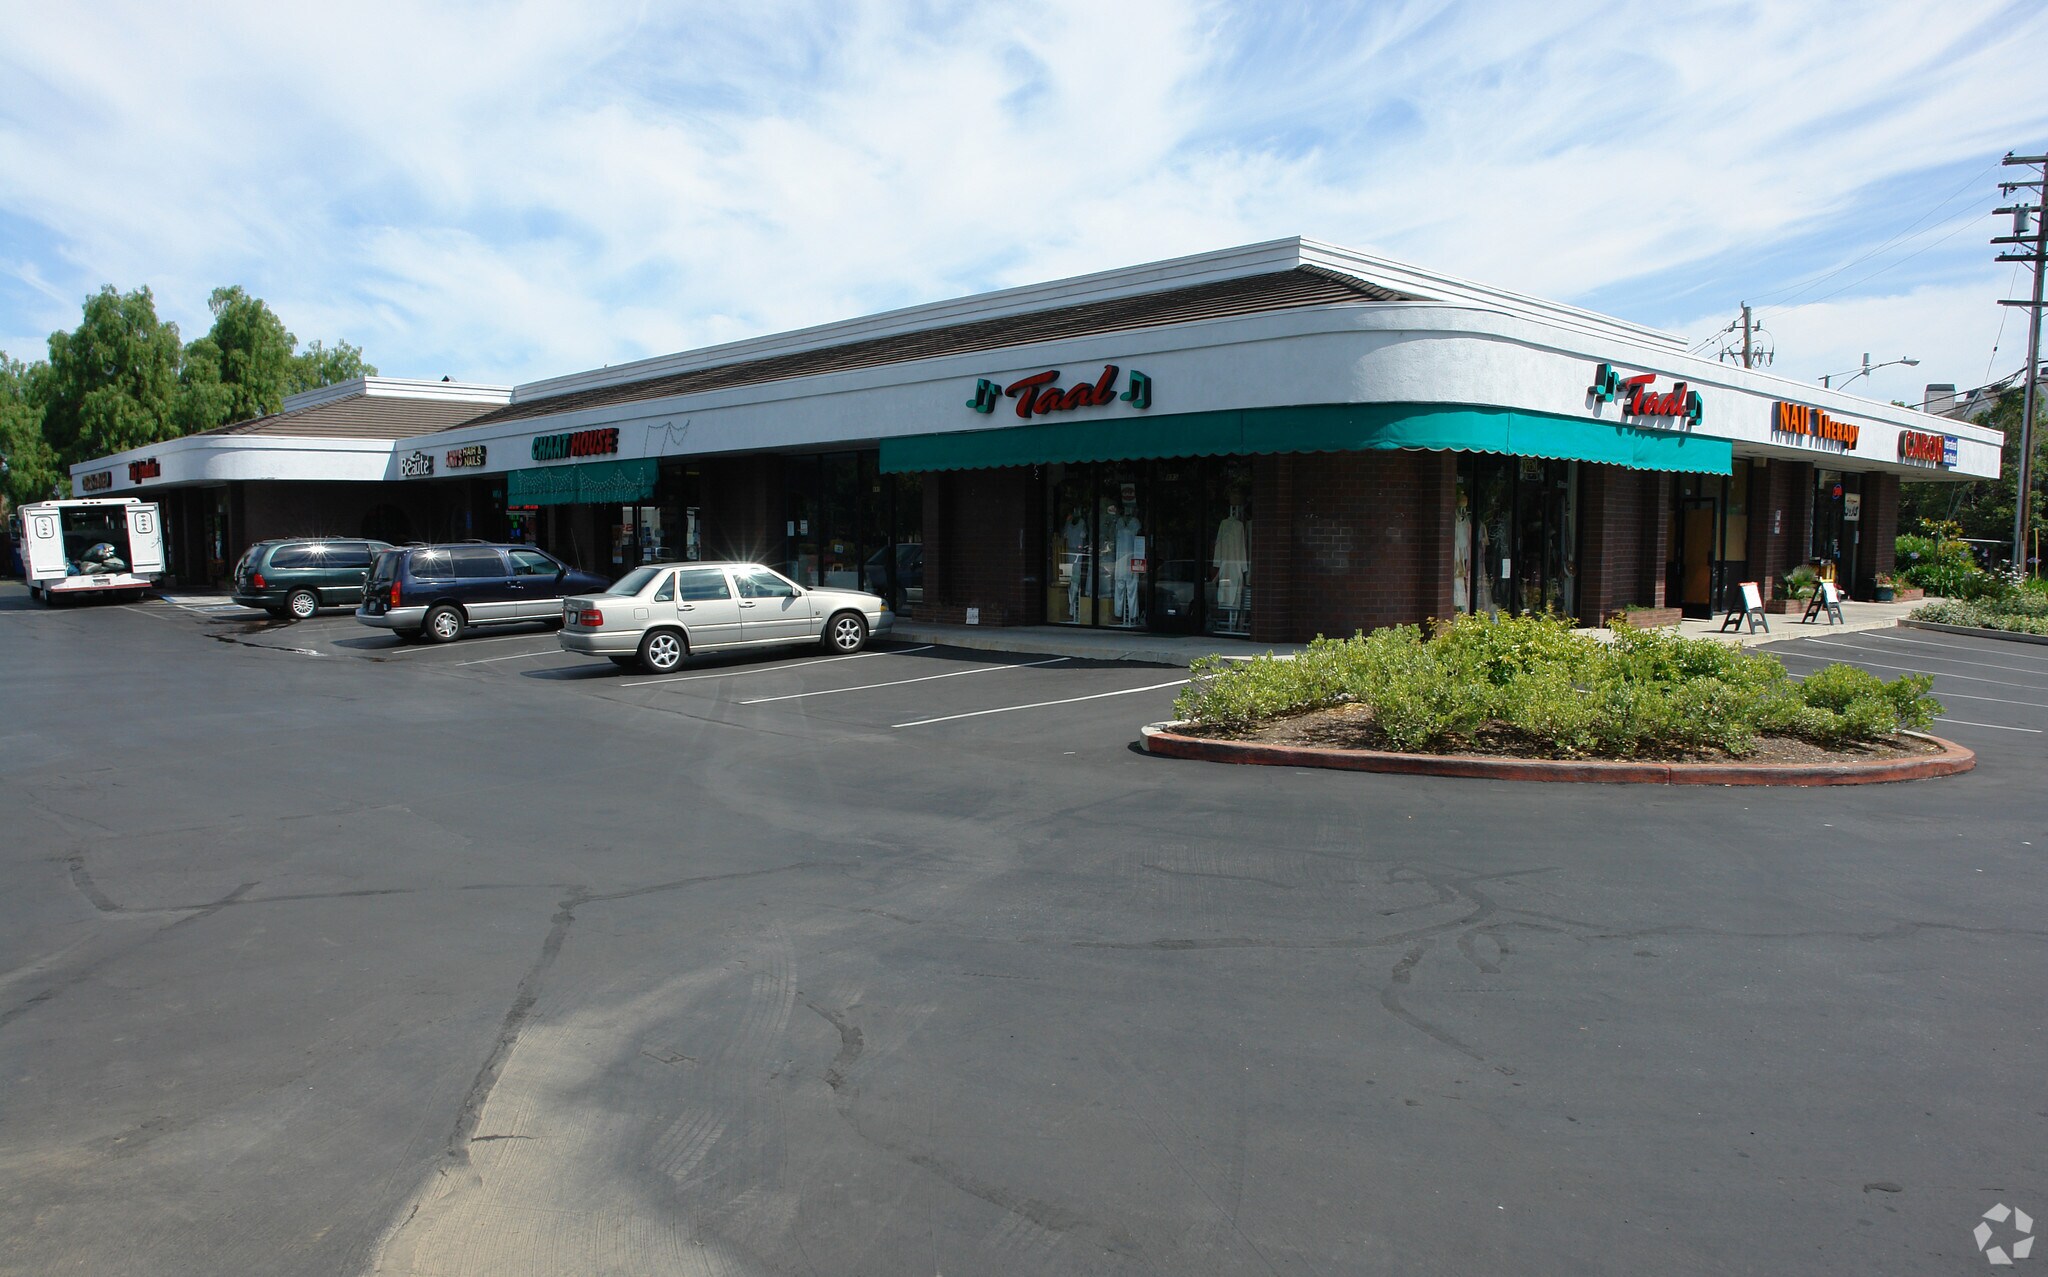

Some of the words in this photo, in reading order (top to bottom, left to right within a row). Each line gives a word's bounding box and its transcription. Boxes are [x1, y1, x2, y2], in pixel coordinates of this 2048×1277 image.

[1004, 364, 1119, 418] Taal
[1622, 373, 1687, 416] Taal
[1779, 401, 1812, 435] NAIL
[464, 456, 482, 466] NAILS
[531, 433, 571, 461] CHAAT
[571, 428, 617, 456] HOUSE
[1904, 430, 1943, 463] CARON
